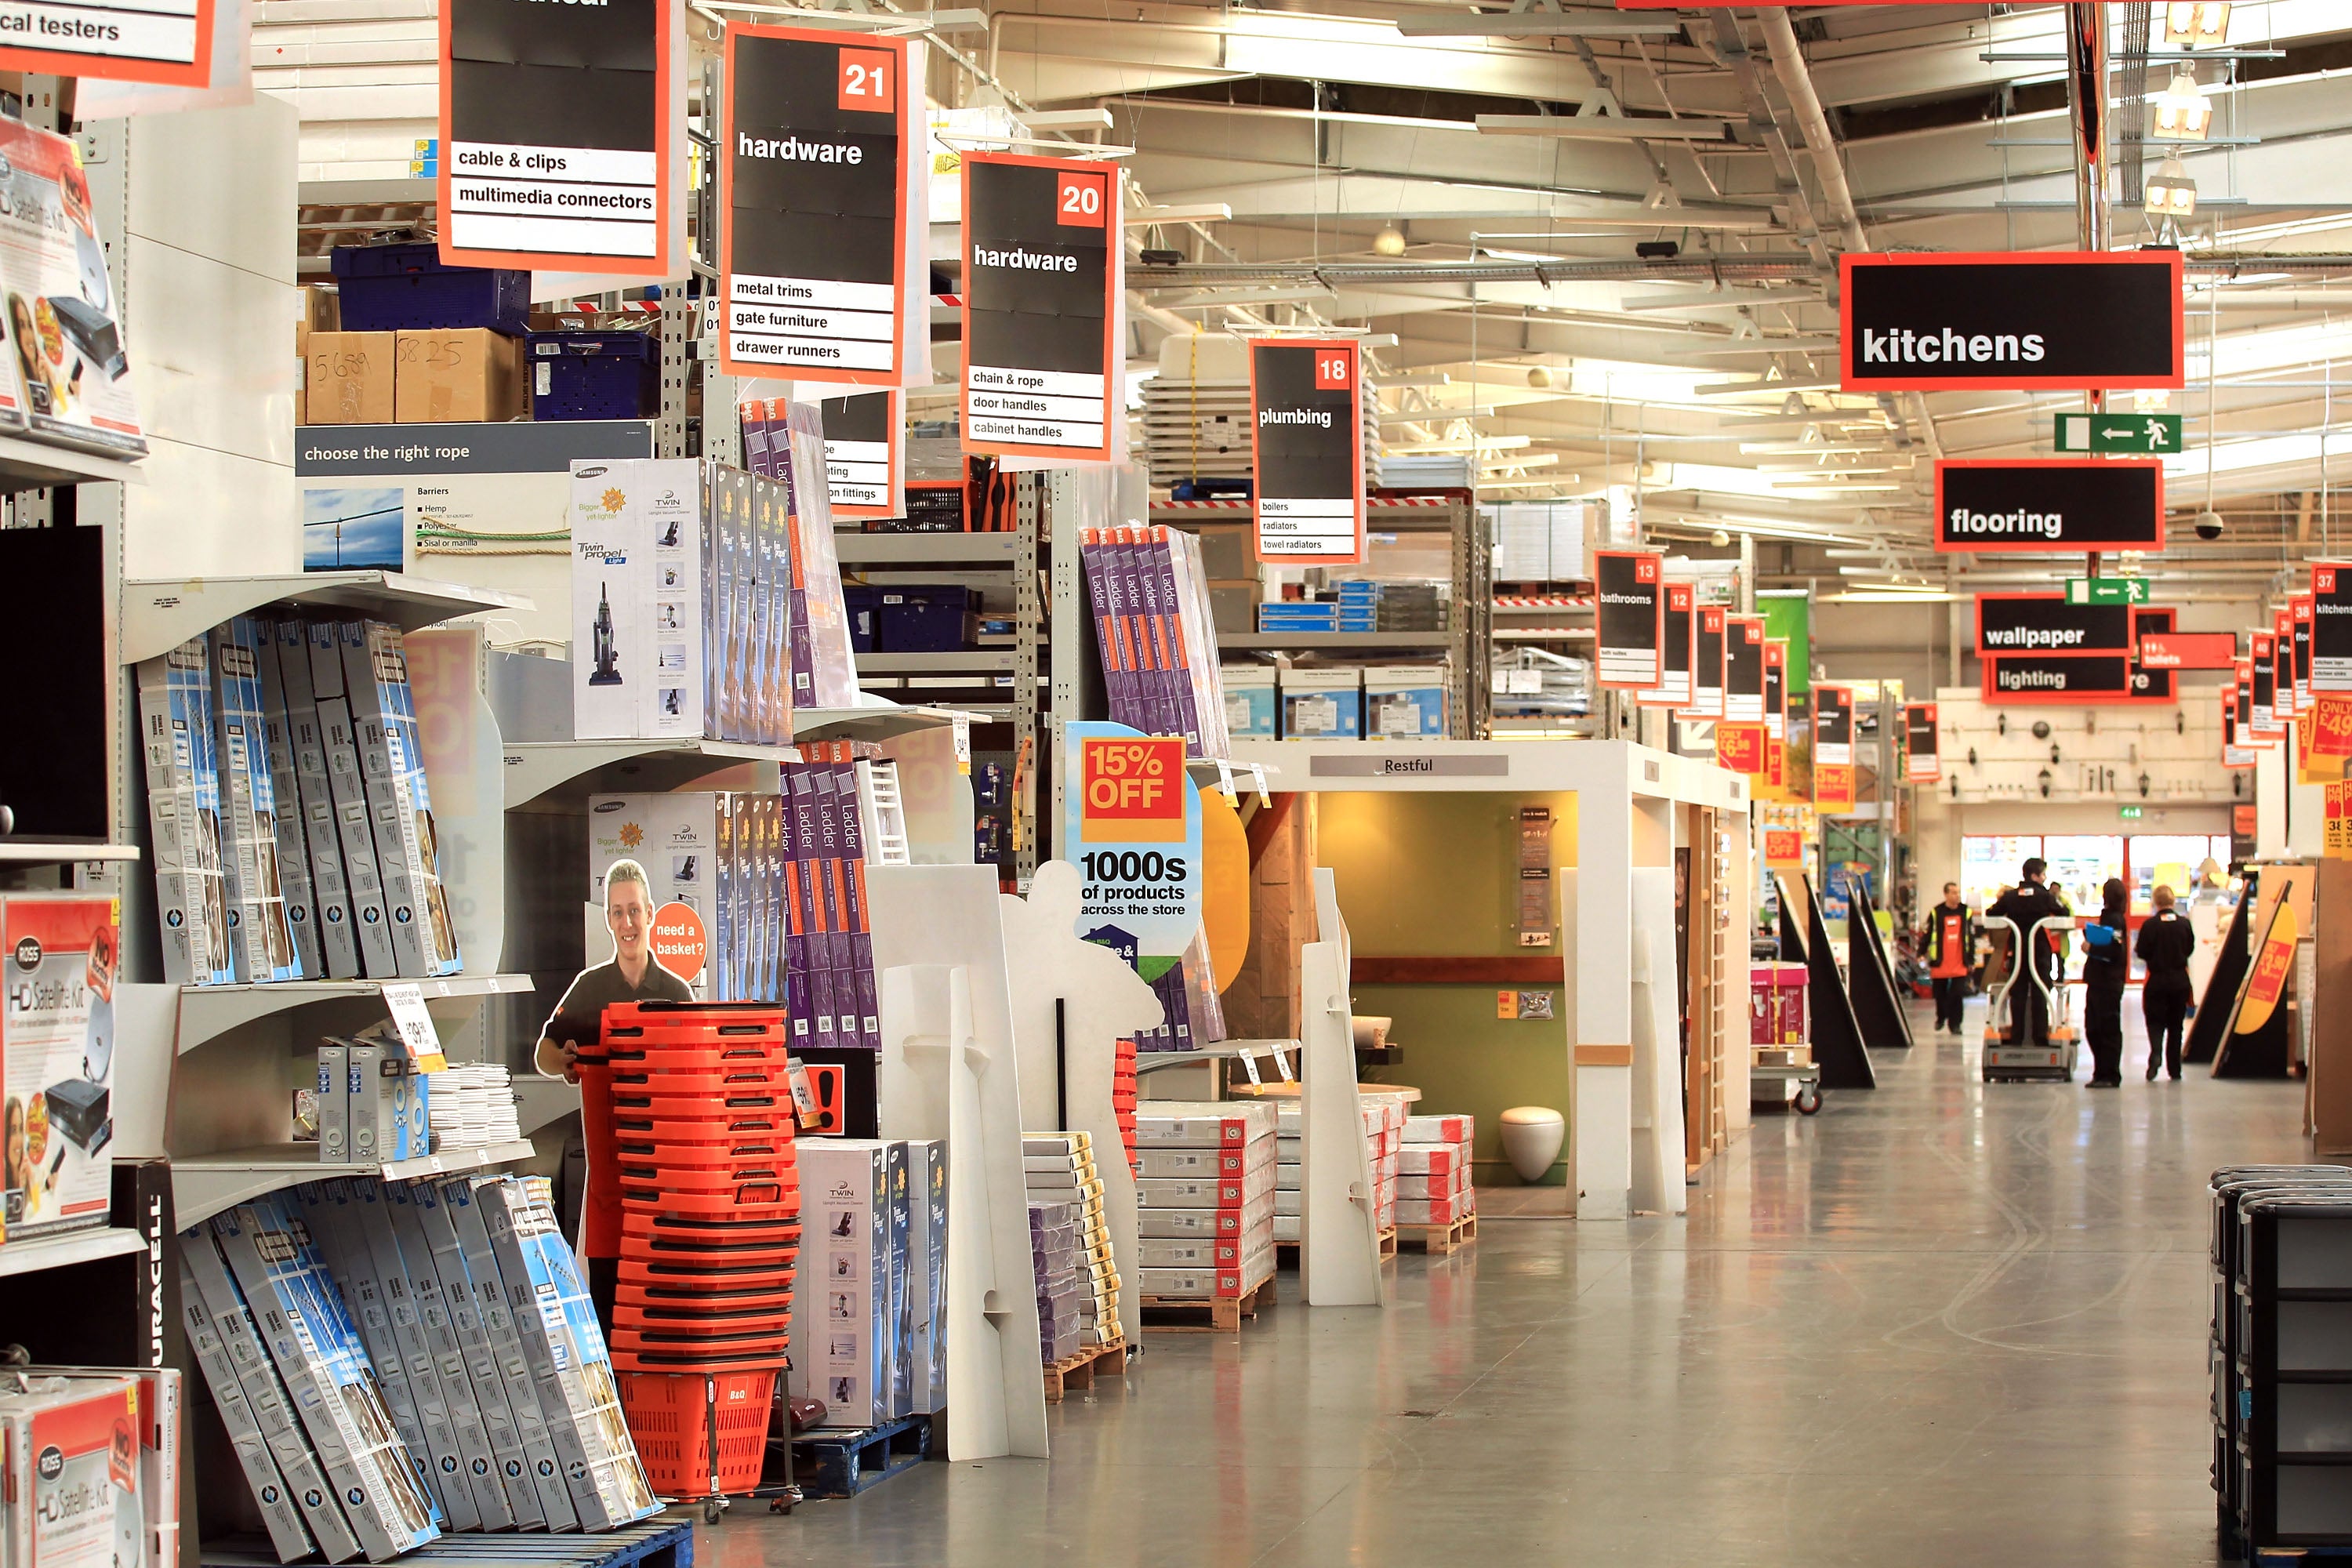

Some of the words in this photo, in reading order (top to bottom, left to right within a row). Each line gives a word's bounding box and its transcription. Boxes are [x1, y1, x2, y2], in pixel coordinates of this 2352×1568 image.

[0, 13, 34, 34] cal
[40, 19, 120, 42] testers
[845, 64, 885, 96] 21
[738, 132, 862, 165] hardware
[459, 151, 503, 167] cable
[509, 153, 521, 167] &
[526, 154, 566, 172] clips
[459, 187, 552, 205] multimedia
[557, 193, 652, 209] connectors
[1063, 187, 1099, 214] 20
[975, 245, 1078, 273] hardware
[736, 281, 779, 299] metal
[784, 285, 812, 299] trims
[707, 319, 719, 329] 01
[735, 311, 765, 328] gate
[769, 313, 828, 328] furniture
[426, 341, 463, 366] 25
[735, 339, 783, 357] drawer
[786, 346, 840, 359] runners
[1864, 328, 2045, 363] kitchens
[1320, 360, 1345, 379] 18
[974, 372, 1004, 384] chain
[1007, 374, 1014, 385] &
[1018, 378, 1044, 388] rope
[768, 401, 776, 419] B&Q
[974, 397, 999, 408] door
[1002, 398, 1047, 412] handles
[1259, 408, 1332, 428] plumbing
[974, 422, 1014, 435] cabinet
[1018, 425, 1062, 437] handles
[305, 447, 358, 460] choose
[364, 445, 389, 459] the
[394, 445, 430, 462] right
[435, 447, 470, 461] rope
[843, 488, 876, 500] fittings
[425, 505, 446, 514] Hemp
[1263, 521, 1298, 530] radiators
[1951, 508, 2062, 539] flooring
[578, 543, 604, 552] Twin
[1264, 540, 1284, 549] towel
[1286, 540, 1322, 549] radiators
[585, 550, 622, 560] propel
[1639, 566, 1653, 578] 13
[2318, 575, 2332, 588] 37
[1092, 575, 1105, 609] Ladder
[1109, 575, 1123, 609] Ladder
[1127, 574, 1139, 608] Ladder
[1144, 574, 1156, 608] Ladder
[1162, 572, 1175, 607] Ladder
[1600, 593, 1652, 605] bathrooms
[1672, 594, 1686, 605] 12
[2296, 606, 2309, 618] 38
[1708, 617, 1719, 627] 11
[1748, 630, 1759, 639] 10
[1986, 626, 2085, 648] wallpaper
[2145, 653, 2180, 665] toilets
[1999, 671, 2066, 690] lighting
[2320, 702, 2352, 713] ONLY
[833, 743, 841, 762] B&Q
[1090, 746, 1163, 775] 15%
[1385, 759, 1432, 771] Restful
[1817, 770, 1826, 782] 3
[1841, 771, 1849, 782] 2
[1089, 778, 1163, 808] OFF
[799, 804, 814, 849] Ladder
[821, 804, 836, 848] Ladder
[843, 804, 858, 850] Ladder
[1767, 846, 1794, 856] OFF
[1080, 851, 1186, 882] 1000s
[789, 863, 797, 890] Decorative
[1081, 884, 1101, 899] of
[1105, 884, 1185, 904] products
[1081, 905, 1124, 916] across
[1128, 904, 1149, 916] the
[1152, 905, 1185, 916] store
[657, 924, 684, 936] need
[688, 927, 695, 936] a
[18, 947, 40, 962] ROSS
[657, 942, 703, 956] basket?
[1123, 945, 1134, 956] &
[9, 983, 33, 1012] HD
[34, 978, 69, 1011] Satellite
[71, 982, 85, 1009] Kit
[151, 1194, 163, 1367] URACELL
[731, 1390, 746, 1399] B&Q
[40, 1454, 62, 1474] ROSS
[36, 1494, 58, 1528] HD
[59, 1487, 93, 1522] Satellite
[94, 1483, 109, 1510] Kit
